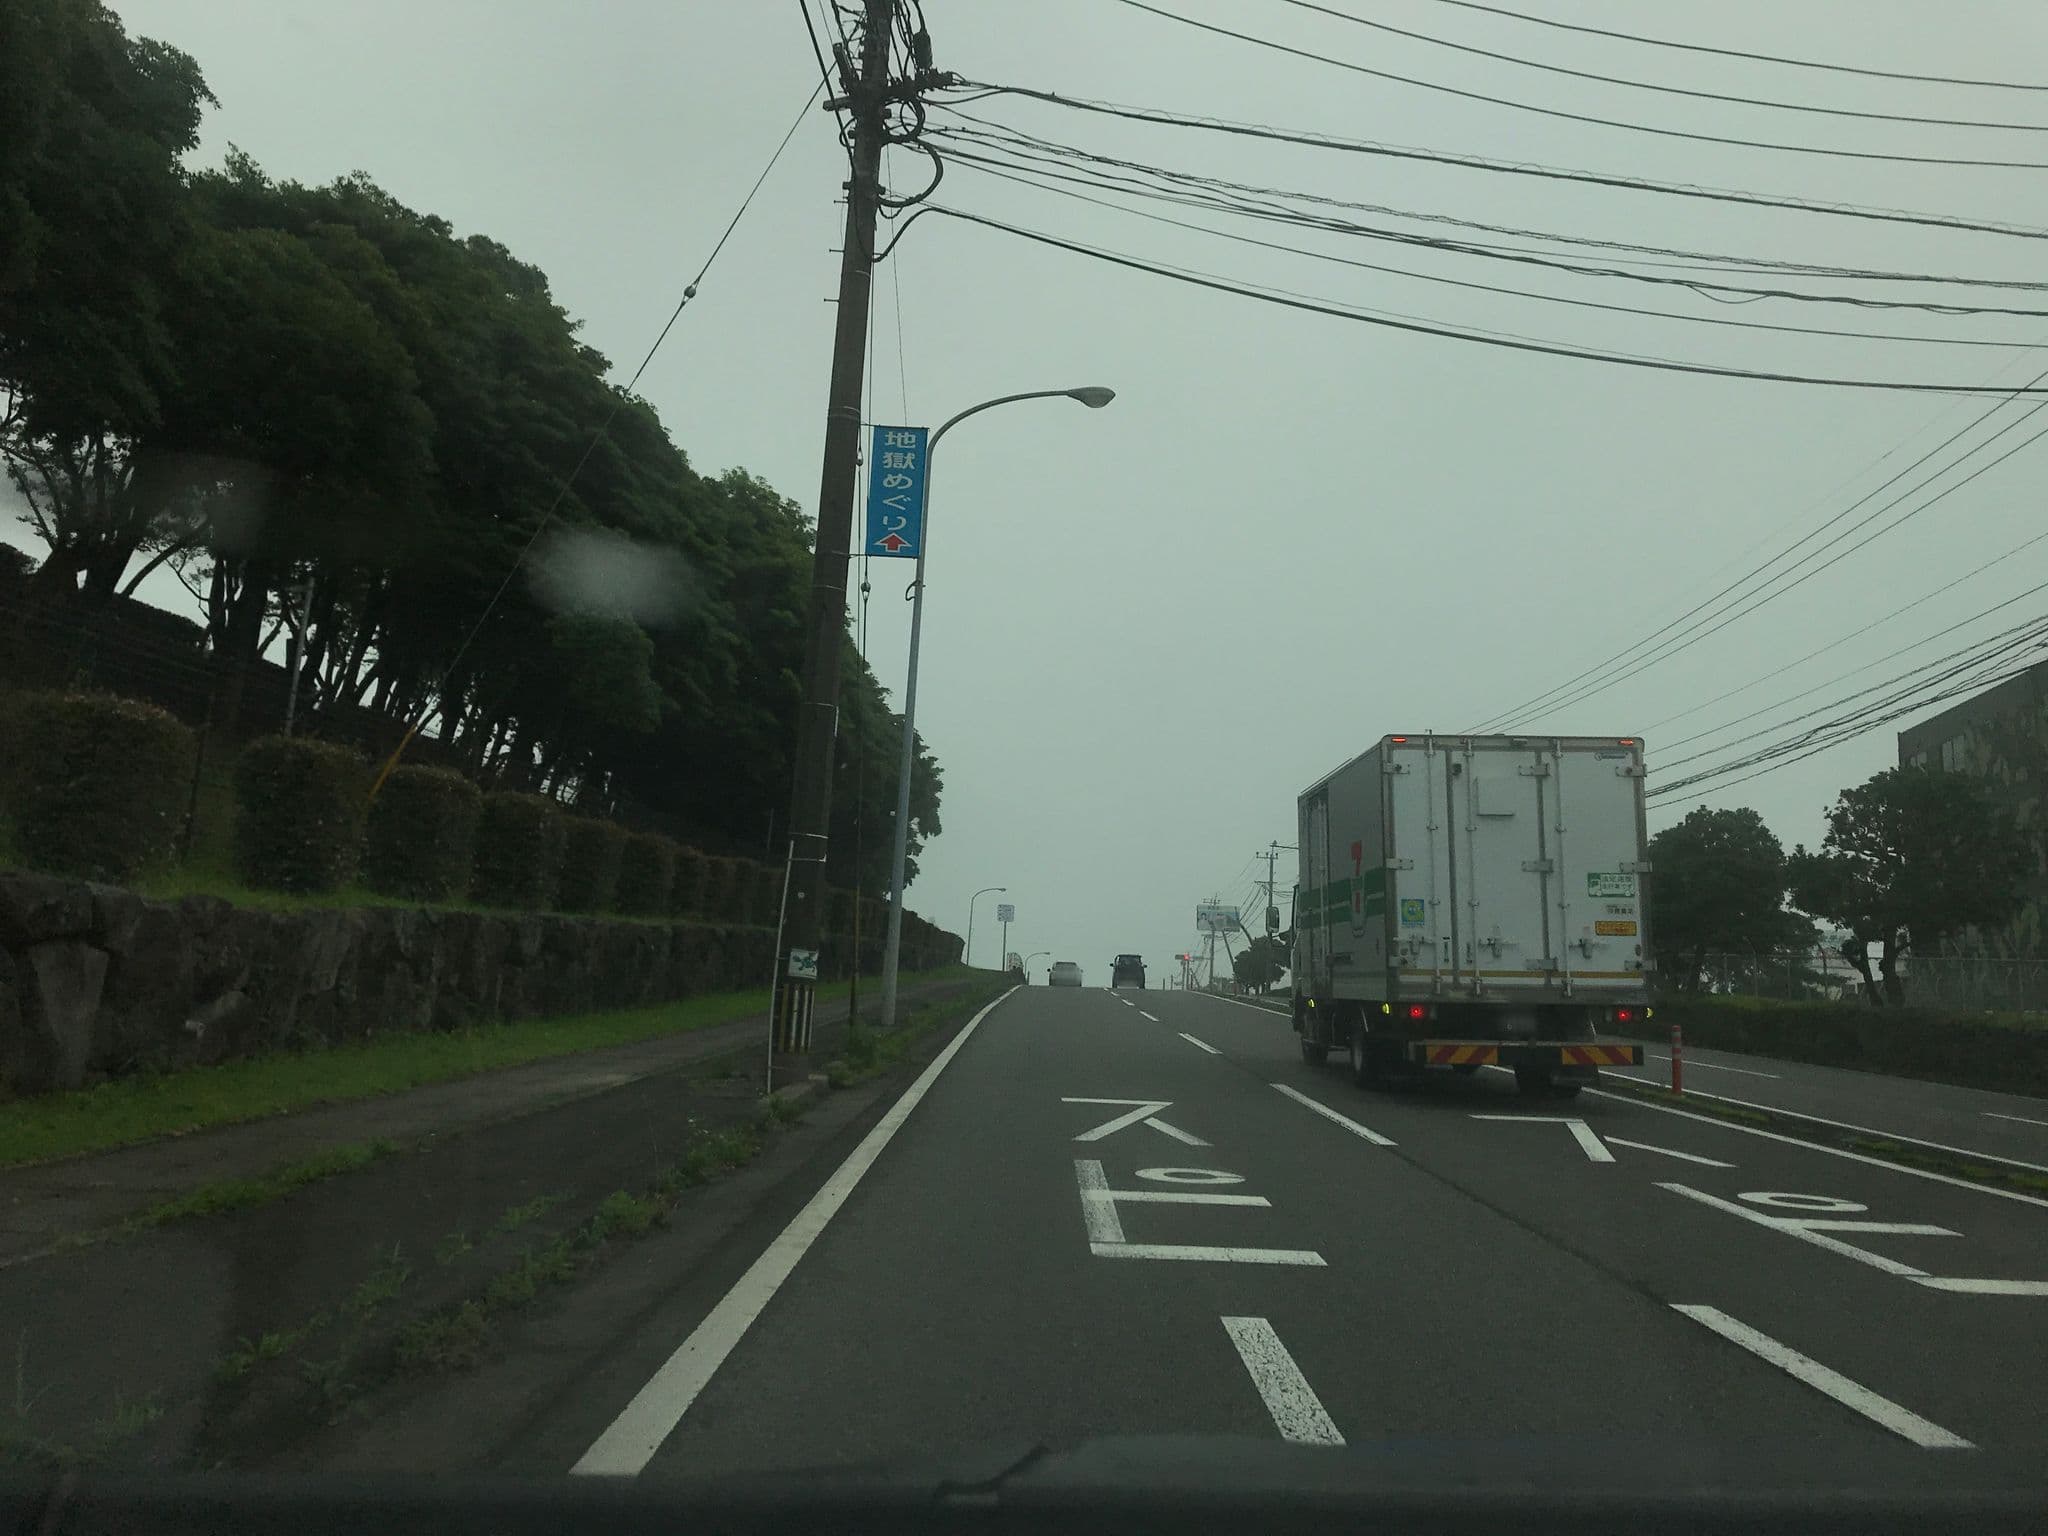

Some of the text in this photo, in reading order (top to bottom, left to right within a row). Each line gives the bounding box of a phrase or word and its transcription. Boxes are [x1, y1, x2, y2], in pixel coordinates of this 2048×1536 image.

[882, 431, 917, 531] 地獄めぐり
